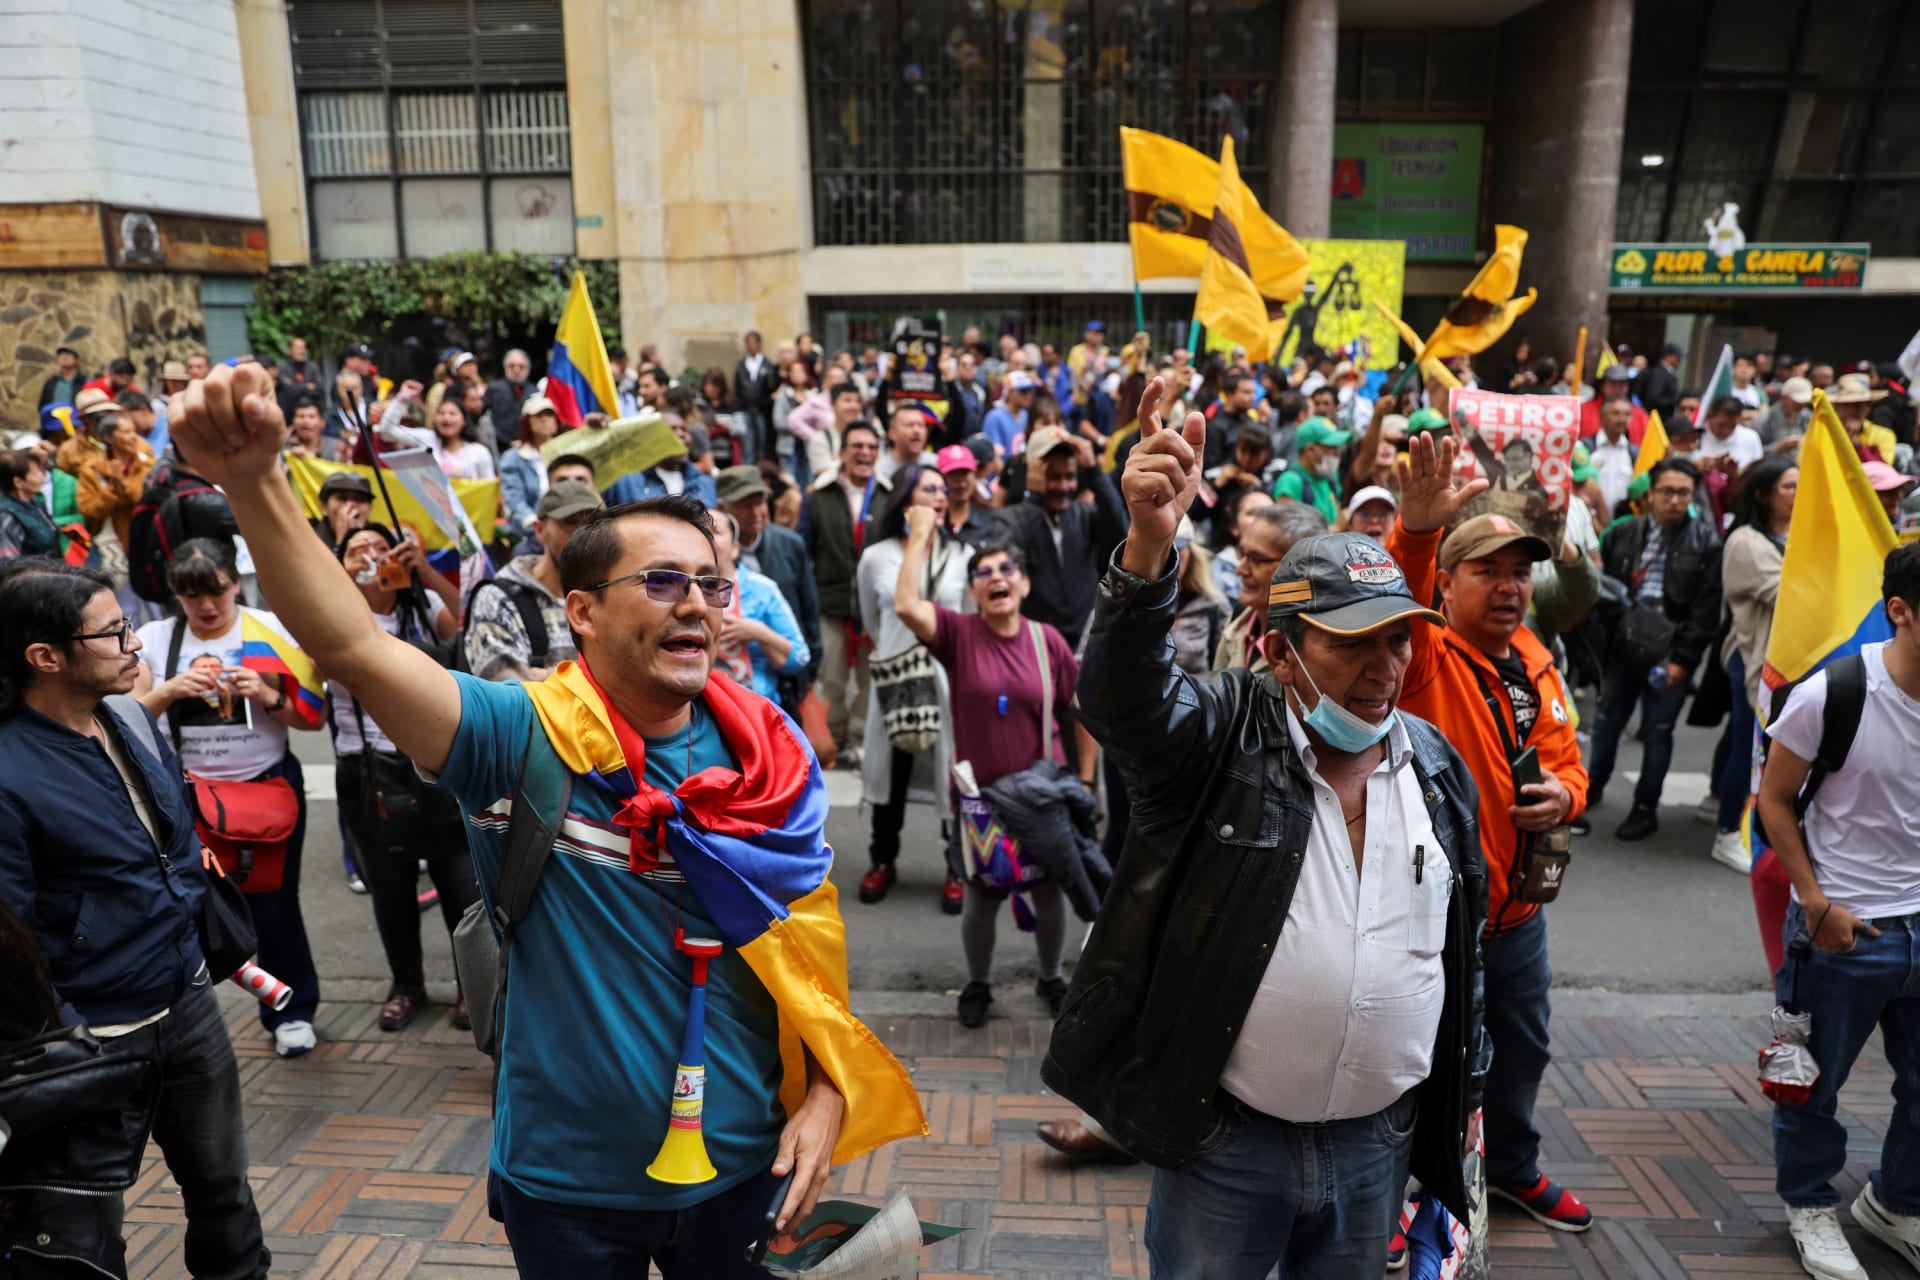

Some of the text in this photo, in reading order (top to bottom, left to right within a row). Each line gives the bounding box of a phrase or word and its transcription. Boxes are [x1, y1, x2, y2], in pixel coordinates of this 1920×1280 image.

[1652, 250, 1707, 273] FLOR
[1745, 249, 1825, 273] CANELA
[1456, 399, 1574, 428] PETRO
[1478, 423, 1571, 456] ETRO
[1359, 567, 1394, 578] KENWORTH
